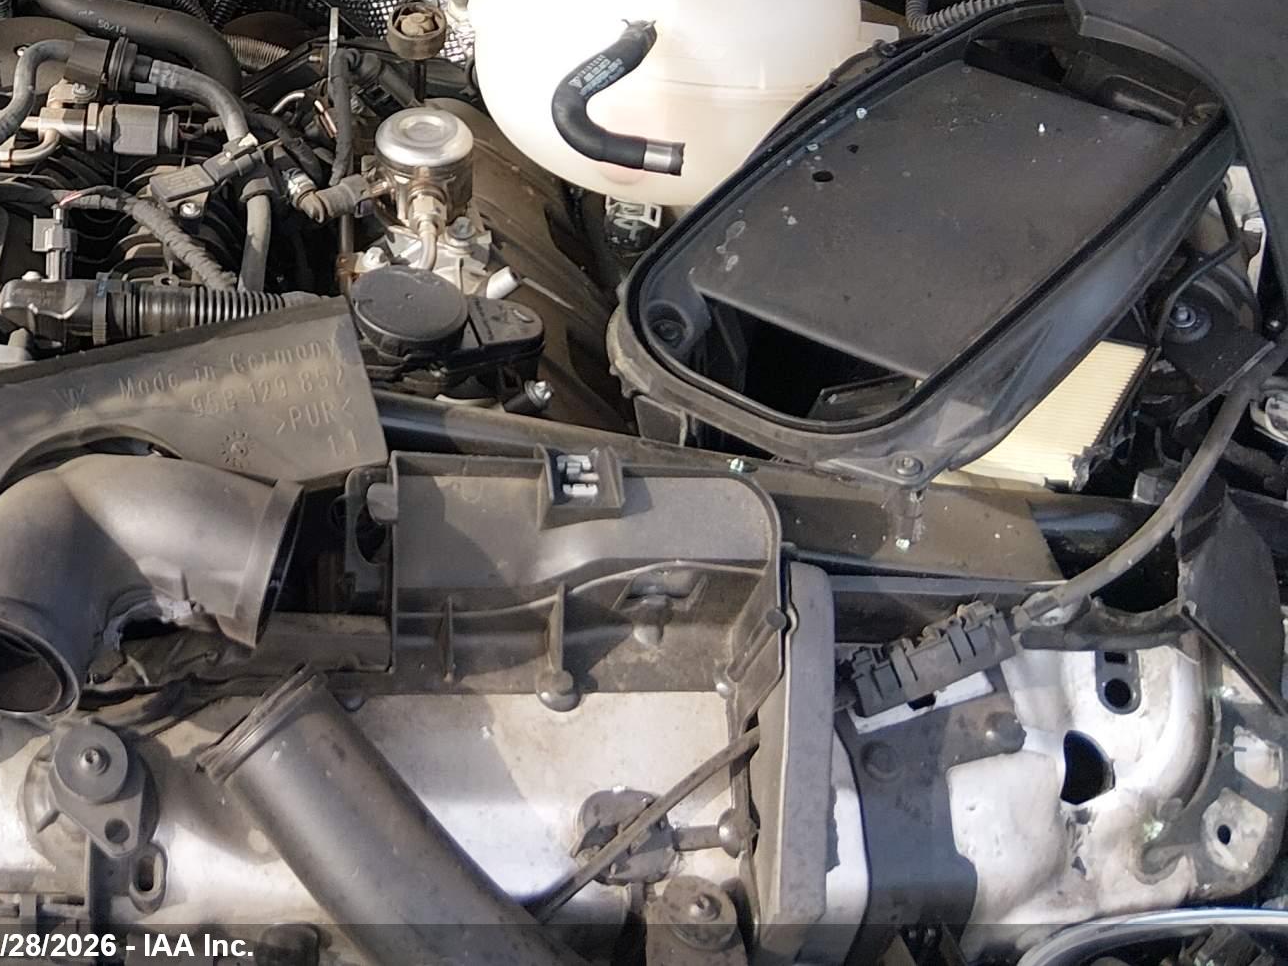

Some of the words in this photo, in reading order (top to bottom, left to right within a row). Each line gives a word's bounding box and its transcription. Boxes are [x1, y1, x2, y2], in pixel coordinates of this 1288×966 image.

[118, 370, 180, 401] Made
[194, 362, 216, 383] in
[230, 338, 338, 375] Germany
[248, 375, 289, 404] 129
